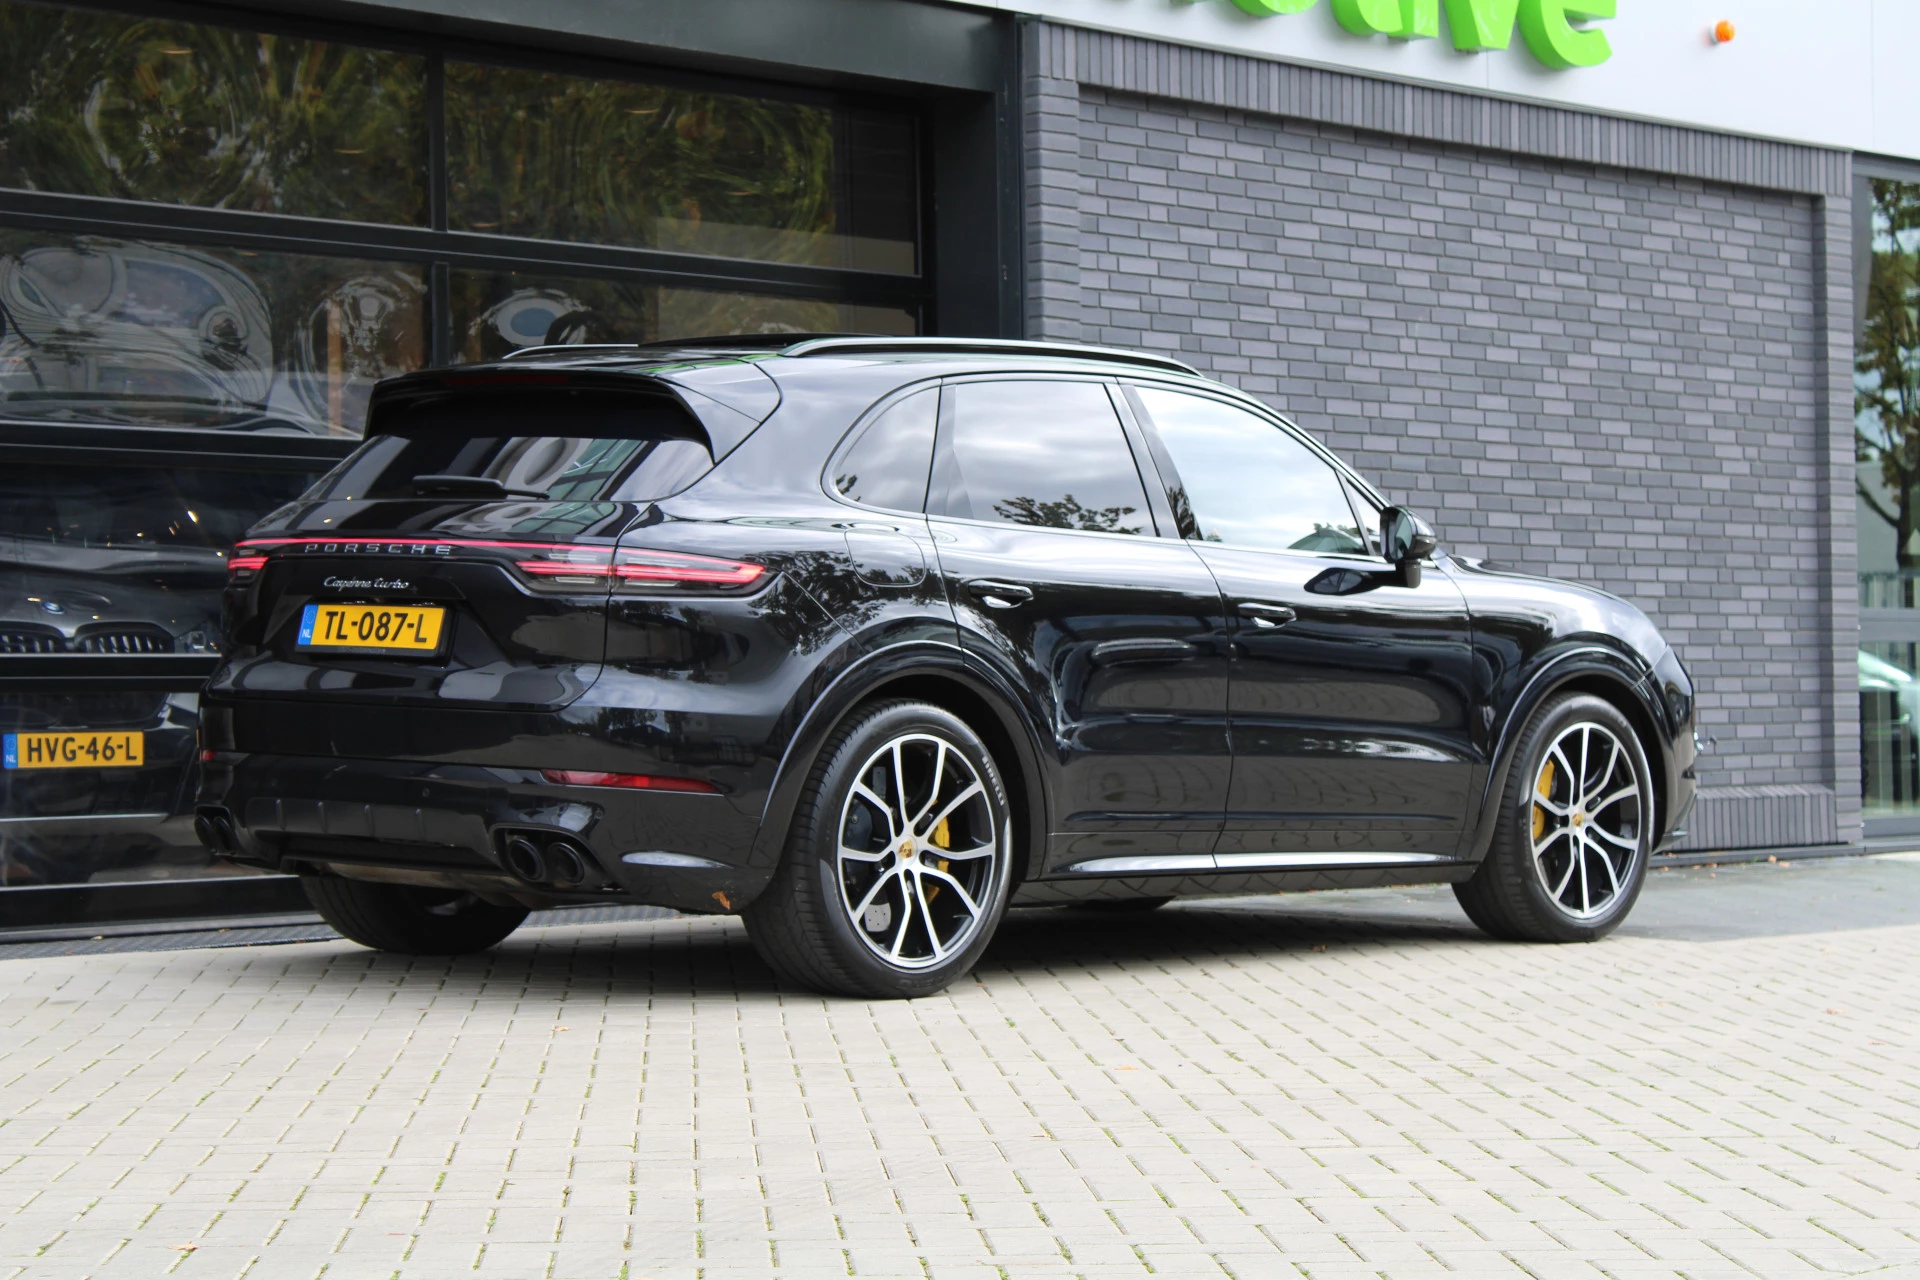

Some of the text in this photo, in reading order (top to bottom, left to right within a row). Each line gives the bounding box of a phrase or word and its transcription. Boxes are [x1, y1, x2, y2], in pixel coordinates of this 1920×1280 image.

[305, 543, 451, 555] PORSCHE
[324, 576, 372, 592] Cayenne
[302, 628, 311, 639] NL
[325, 611, 427, 643] TL-087-L
[27, 736, 137, 763] HVG-46-L
[5, 754, 16, 763] NL
